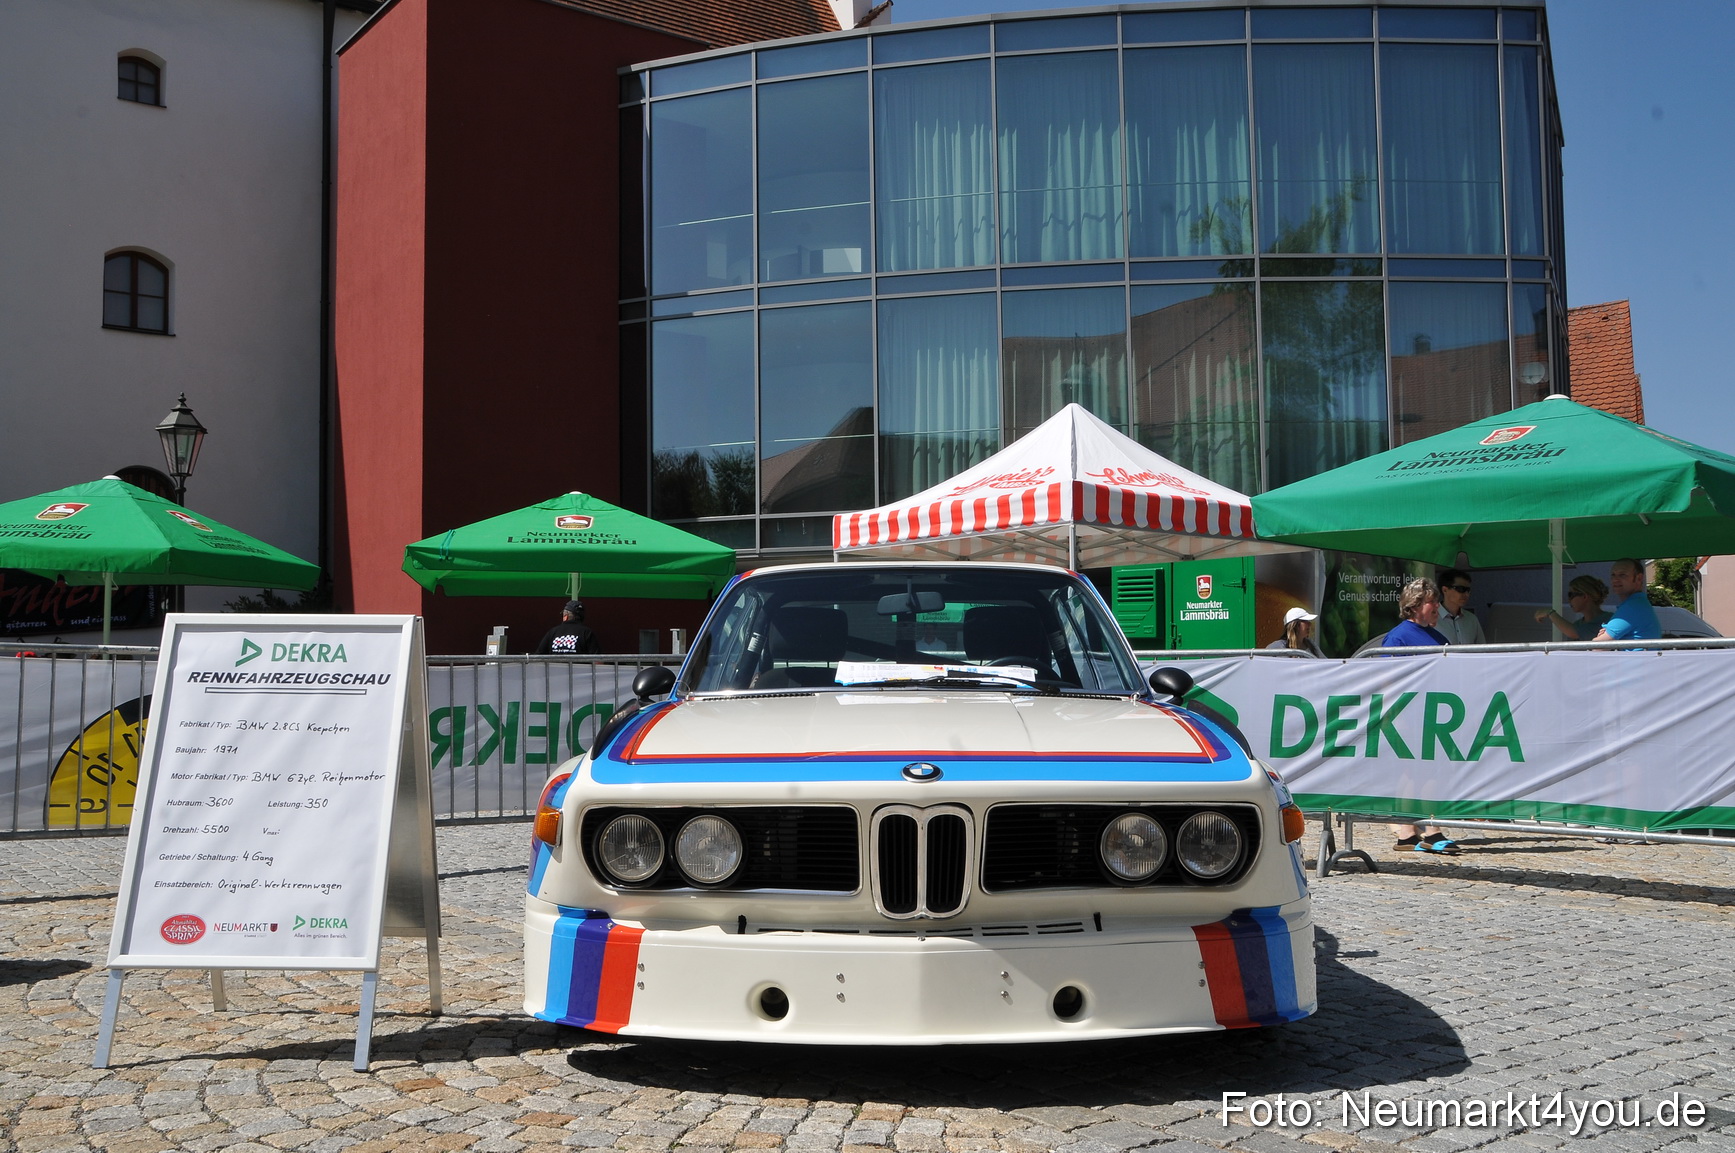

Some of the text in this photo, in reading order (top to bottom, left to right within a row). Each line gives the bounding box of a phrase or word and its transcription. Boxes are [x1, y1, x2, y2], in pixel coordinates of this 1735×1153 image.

[1423, 441, 1554, 460] Neumarkter
[1386, 447, 1567, 471] Lammsbräu
[507, 536, 637, 545] Lammsbräu
[1338, 572, 1401, 588] Verantwortung
[1338, 590, 1400, 602] Genuss schaffe
[1186, 600, 1223, 609] Neumarkter
[1180, 609, 1229, 621] Lammsbräu
[270, 643, 348, 663] DEKRA
[186, 671, 392, 685] RENNFAHRZEUGSCHAU
[179, 720, 210, 728] Fabrikat
[236, 719, 269, 731] BMW
[1269, 690, 1526, 763] DEKRA
[175, 745, 239, 755] Baujahr: 1971
[170, 772, 193, 780] Motor
[194, 773, 226, 781] Fabrikat
[251, 771, 282, 782] BMW
[166, 796, 234, 808] Hubraum: 3600
[267, 798, 329, 809] Leistung: 350
[162, 824, 230, 834] Drehzahl: 5500
[159, 853, 191, 861] Getriebe
[197, 853, 239, 862] Schaltung:
[242, 851, 249, 861] 4
[251, 851, 274, 867] Gang
[154, 880, 213, 889] Einsatzbereich:
[163, 924, 204, 933] CLASSIC
[213, 922, 268, 932] NEUMARKT
[310, 917, 348, 929] DEKRA
[165, 931, 201, 940] SPRINT
